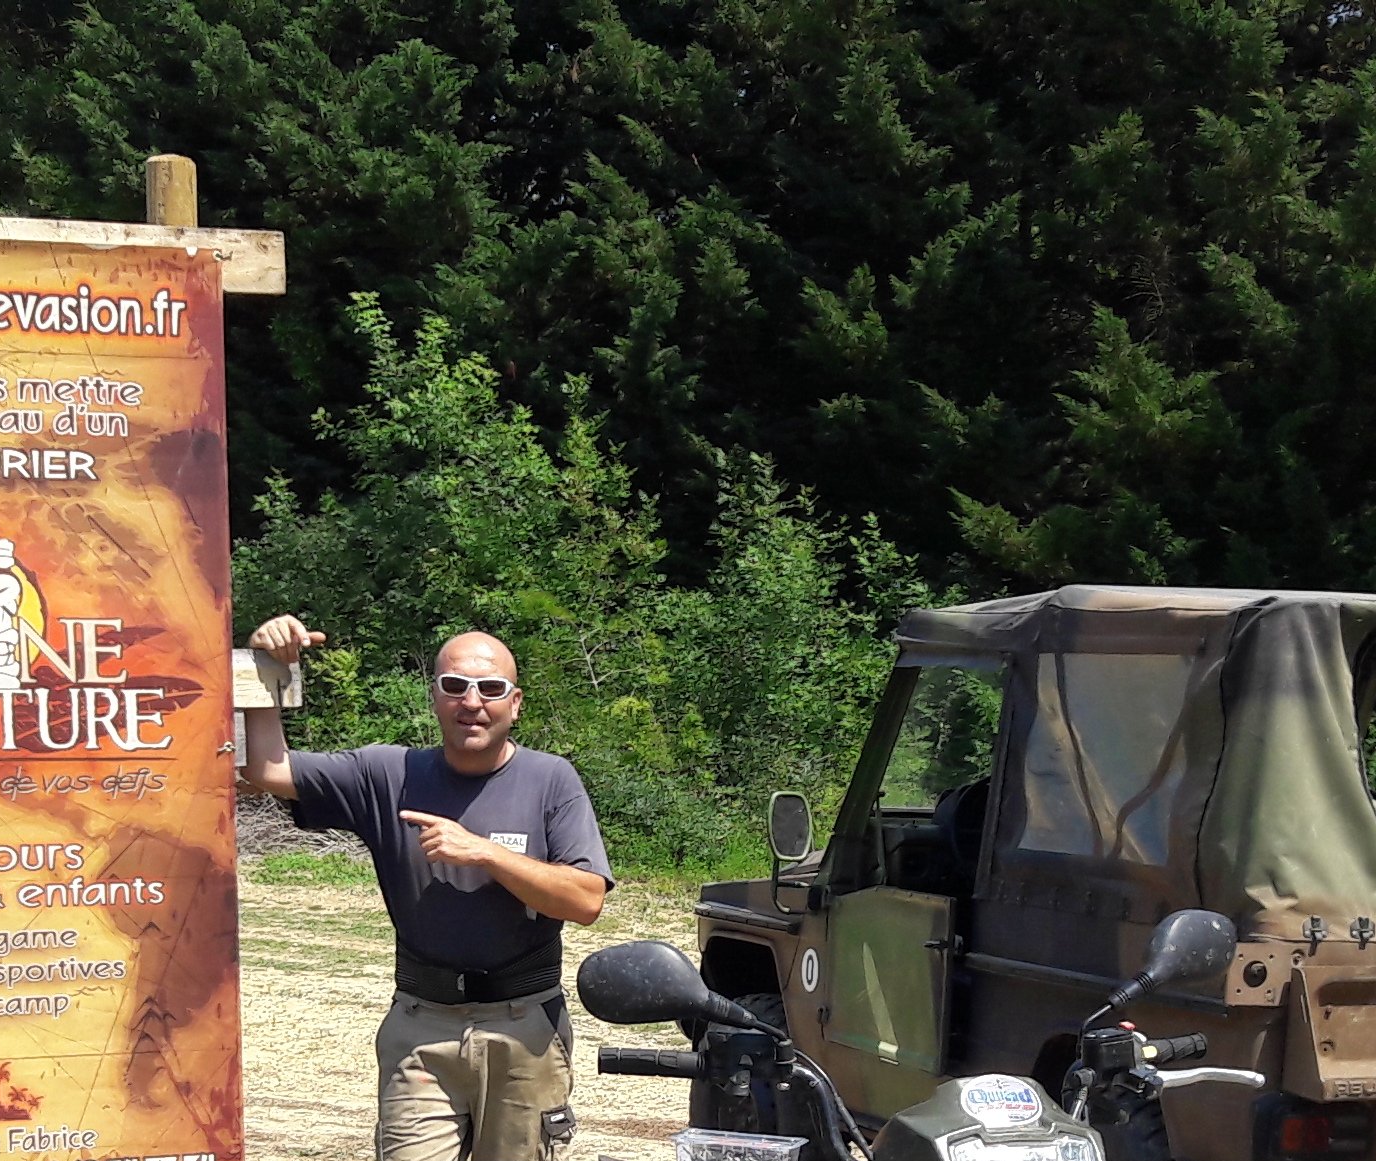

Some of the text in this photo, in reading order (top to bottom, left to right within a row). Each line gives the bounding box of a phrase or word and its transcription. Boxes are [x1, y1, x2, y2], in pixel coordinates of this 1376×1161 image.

[16, 377, 144, 407] mettre
[53, 403, 129, 437] d'un
[0, 765, 38, 801] de
[42, 773, 94, 794] vos
[21, 876, 164, 908] enfants
[7, 1126, 99, 1154] Fabrice
